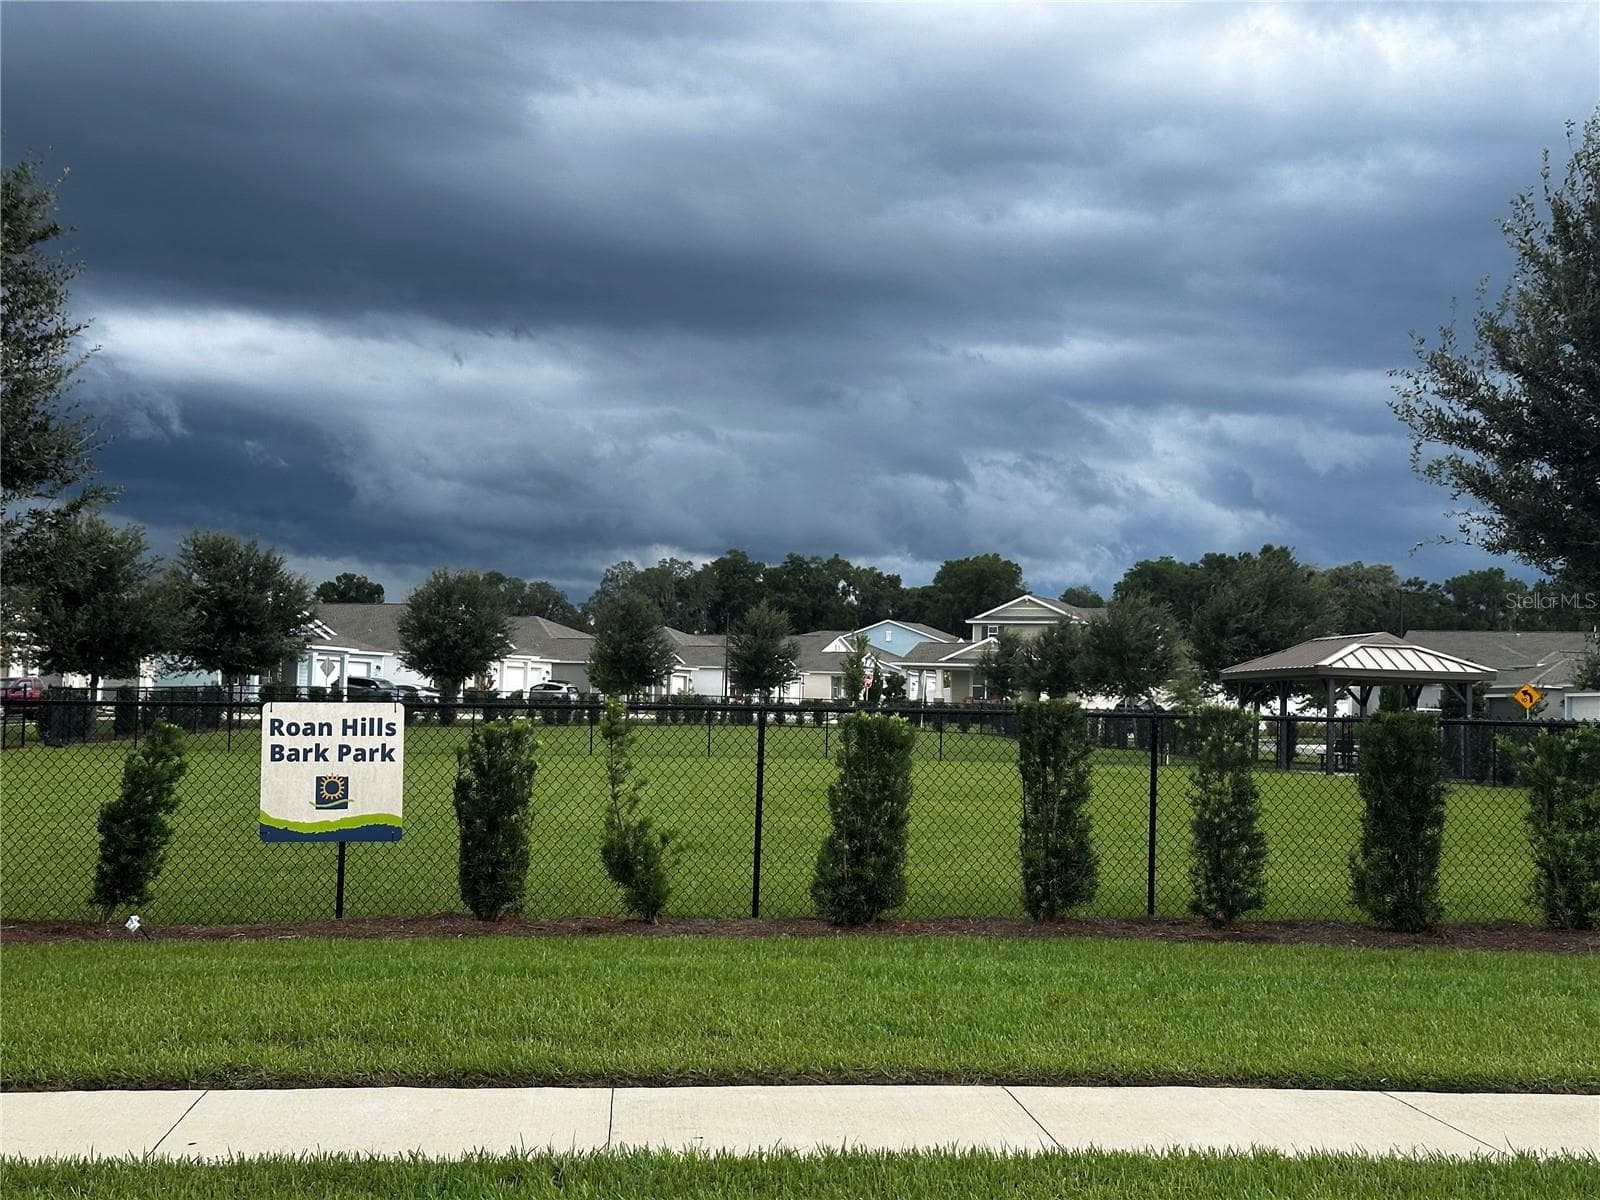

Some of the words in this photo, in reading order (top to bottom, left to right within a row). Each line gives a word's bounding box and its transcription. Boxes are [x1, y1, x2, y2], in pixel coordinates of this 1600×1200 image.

[269, 718, 333, 737] Roan
[341, 717, 397, 737] Hills
[270, 742, 329, 762] Bark
[337, 742, 396, 762] Park
